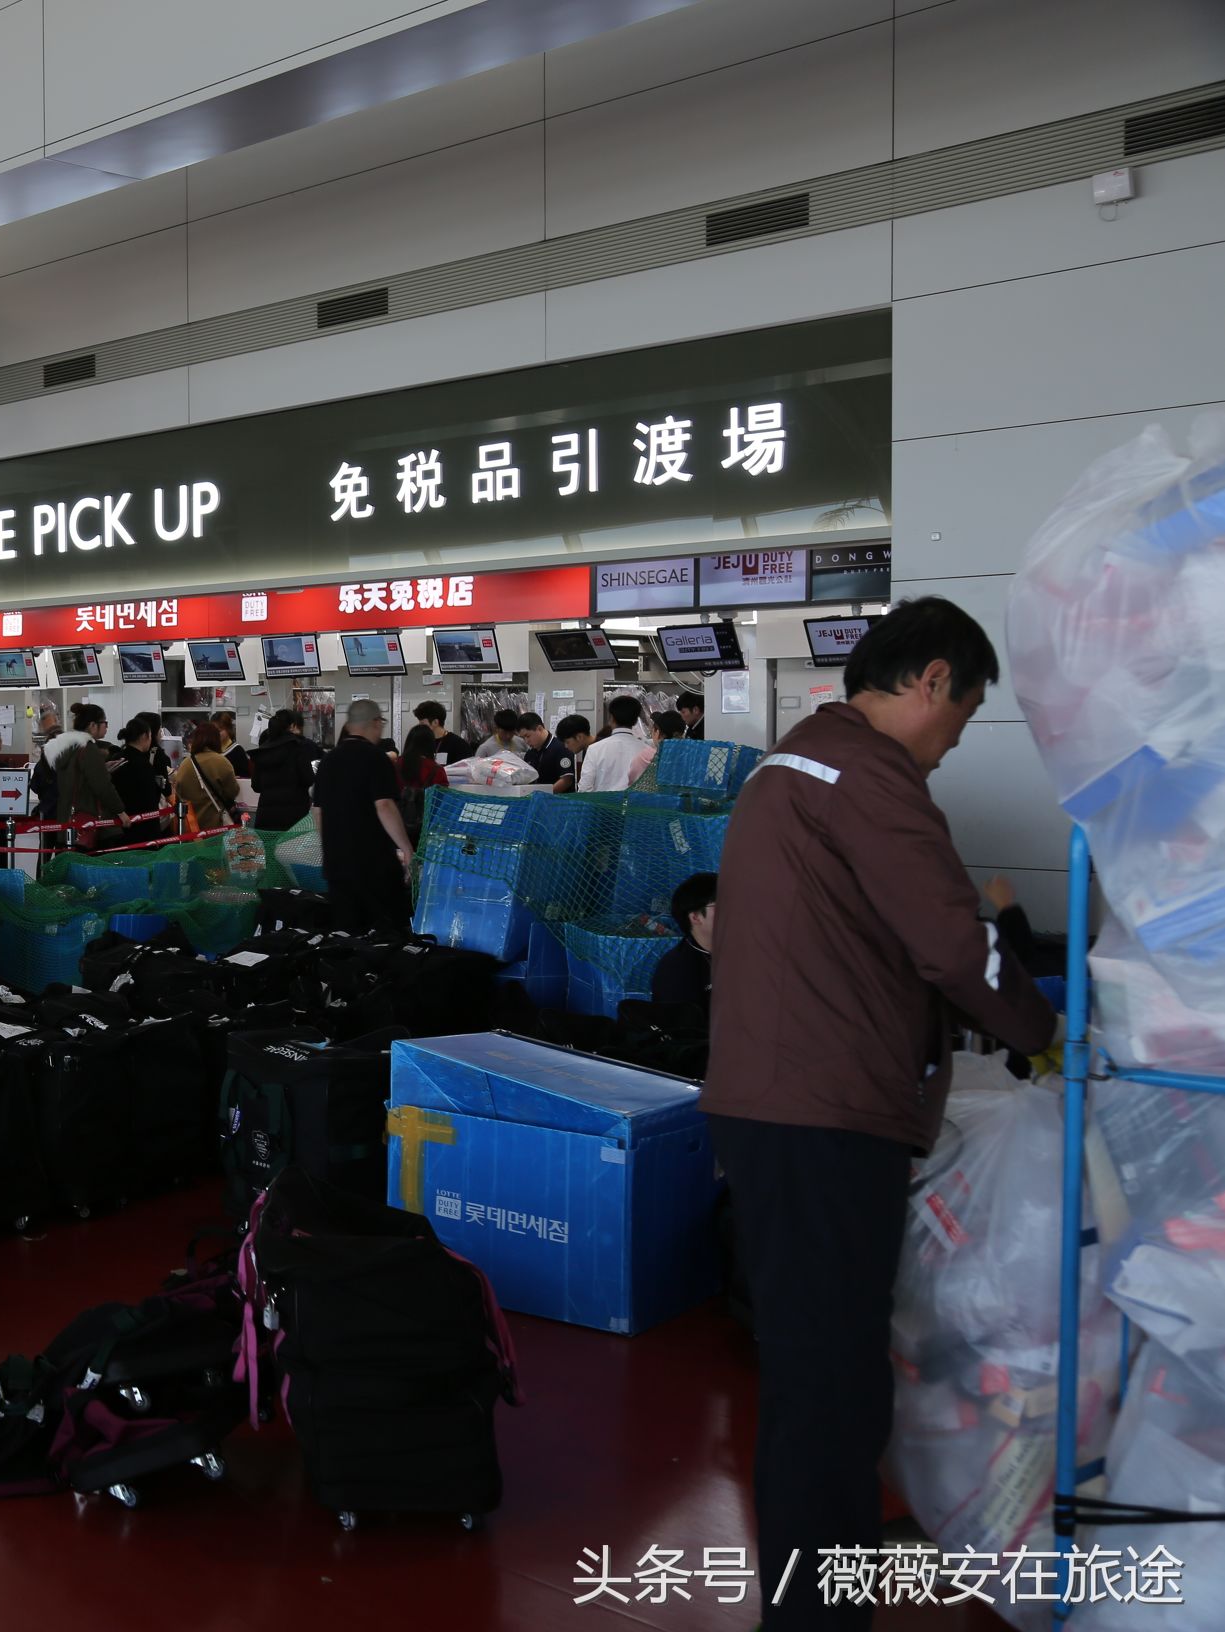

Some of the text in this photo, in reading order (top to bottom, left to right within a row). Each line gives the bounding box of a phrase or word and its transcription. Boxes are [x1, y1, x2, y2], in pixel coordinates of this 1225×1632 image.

[329, 402, 787, 522] 免税品引渡場
[33, 492, 136, 556] PICK
[154, 481, 220, 542] UP
[763, 551, 793, 563] DUTY
[762, 563, 793, 575] FREE
[601, 568, 688, 587] SHINSEGAE
[338, 576, 474, 614] 乐天免税店
[244, 600, 264, 608] DUTY
[665, 635, 713, 647] Galleria
[436, 1188, 461, 1199] LOTTE
[438, 1199, 458, 1209] DUTY
[438, 1207, 460, 1218] FREE
[465, 1201, 569, 1244] 롯데면세점
